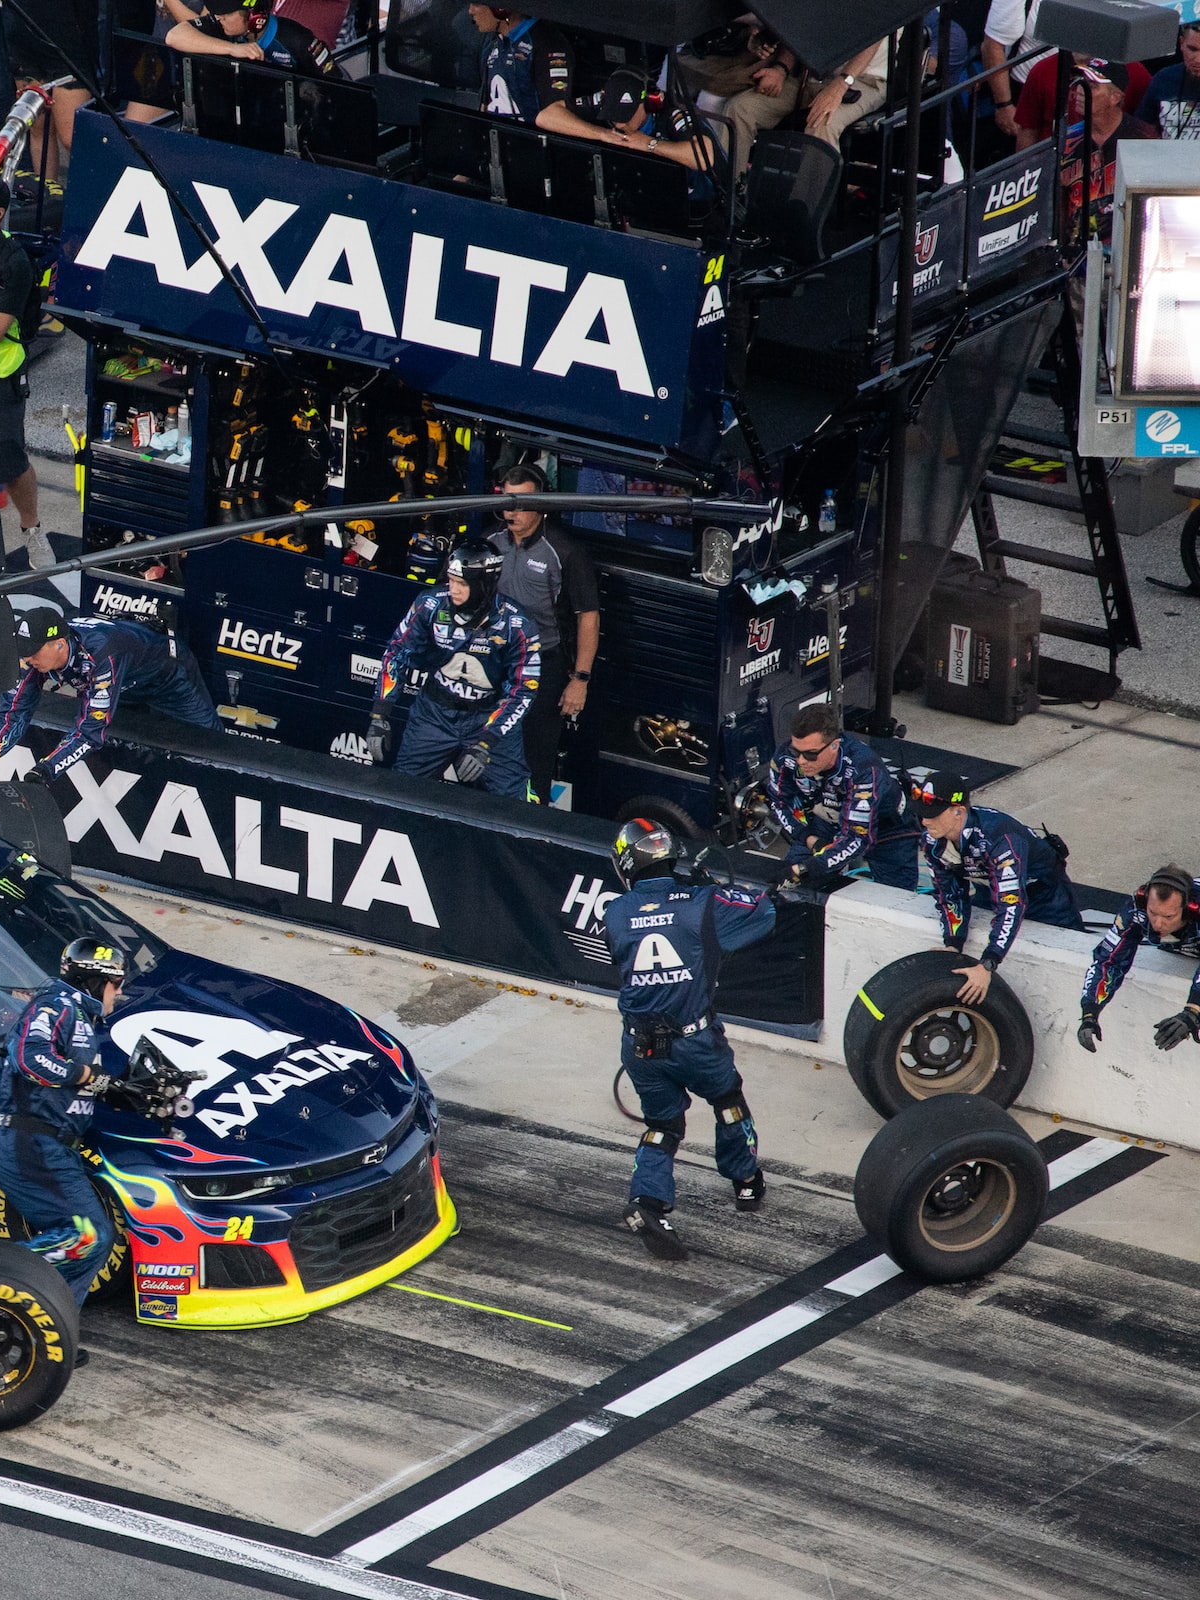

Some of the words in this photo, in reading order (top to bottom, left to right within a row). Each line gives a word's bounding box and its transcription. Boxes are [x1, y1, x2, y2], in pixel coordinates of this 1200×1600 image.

[985, 168, 1042, 213] Hertz
[981, 235, 1010, 253] UniFirst
[75, 167, 656, 398] AXALTA
[704, 254, 725, 285] 24
[697, 309, 725, 328] AXALTA
[1100, 412, 1128, 423] P51
[1162, 444, 1196, 455] FPL
[93, 585, 158, 616] Hendri
[218, 617, 302, 663] Hertz
[739, 663, 780, 687] UNIVERSITY
[740, 649, 781, 679] LIBERTY
[501, 697, 532, 735] AXALTA
[54, 741, 91, 774] AXALTA
[827, 837, 862, 868] AXALTA
[630, 913, 674, 929] DICKEY
[996, 905, 1017, 949] AXALTA
[94, 946, 113, 961] 24
[631, 969, 693, 987] AXALTA
[195, 1042, 374, 1139] AXALTA
[224, 1215, 254, 1242] 24
[136, 1263, 195, 1276] MOOG
[140, 1277, 185, 1292] Edelbrock
[140, 1303, 176, 1313] SUNOCO
